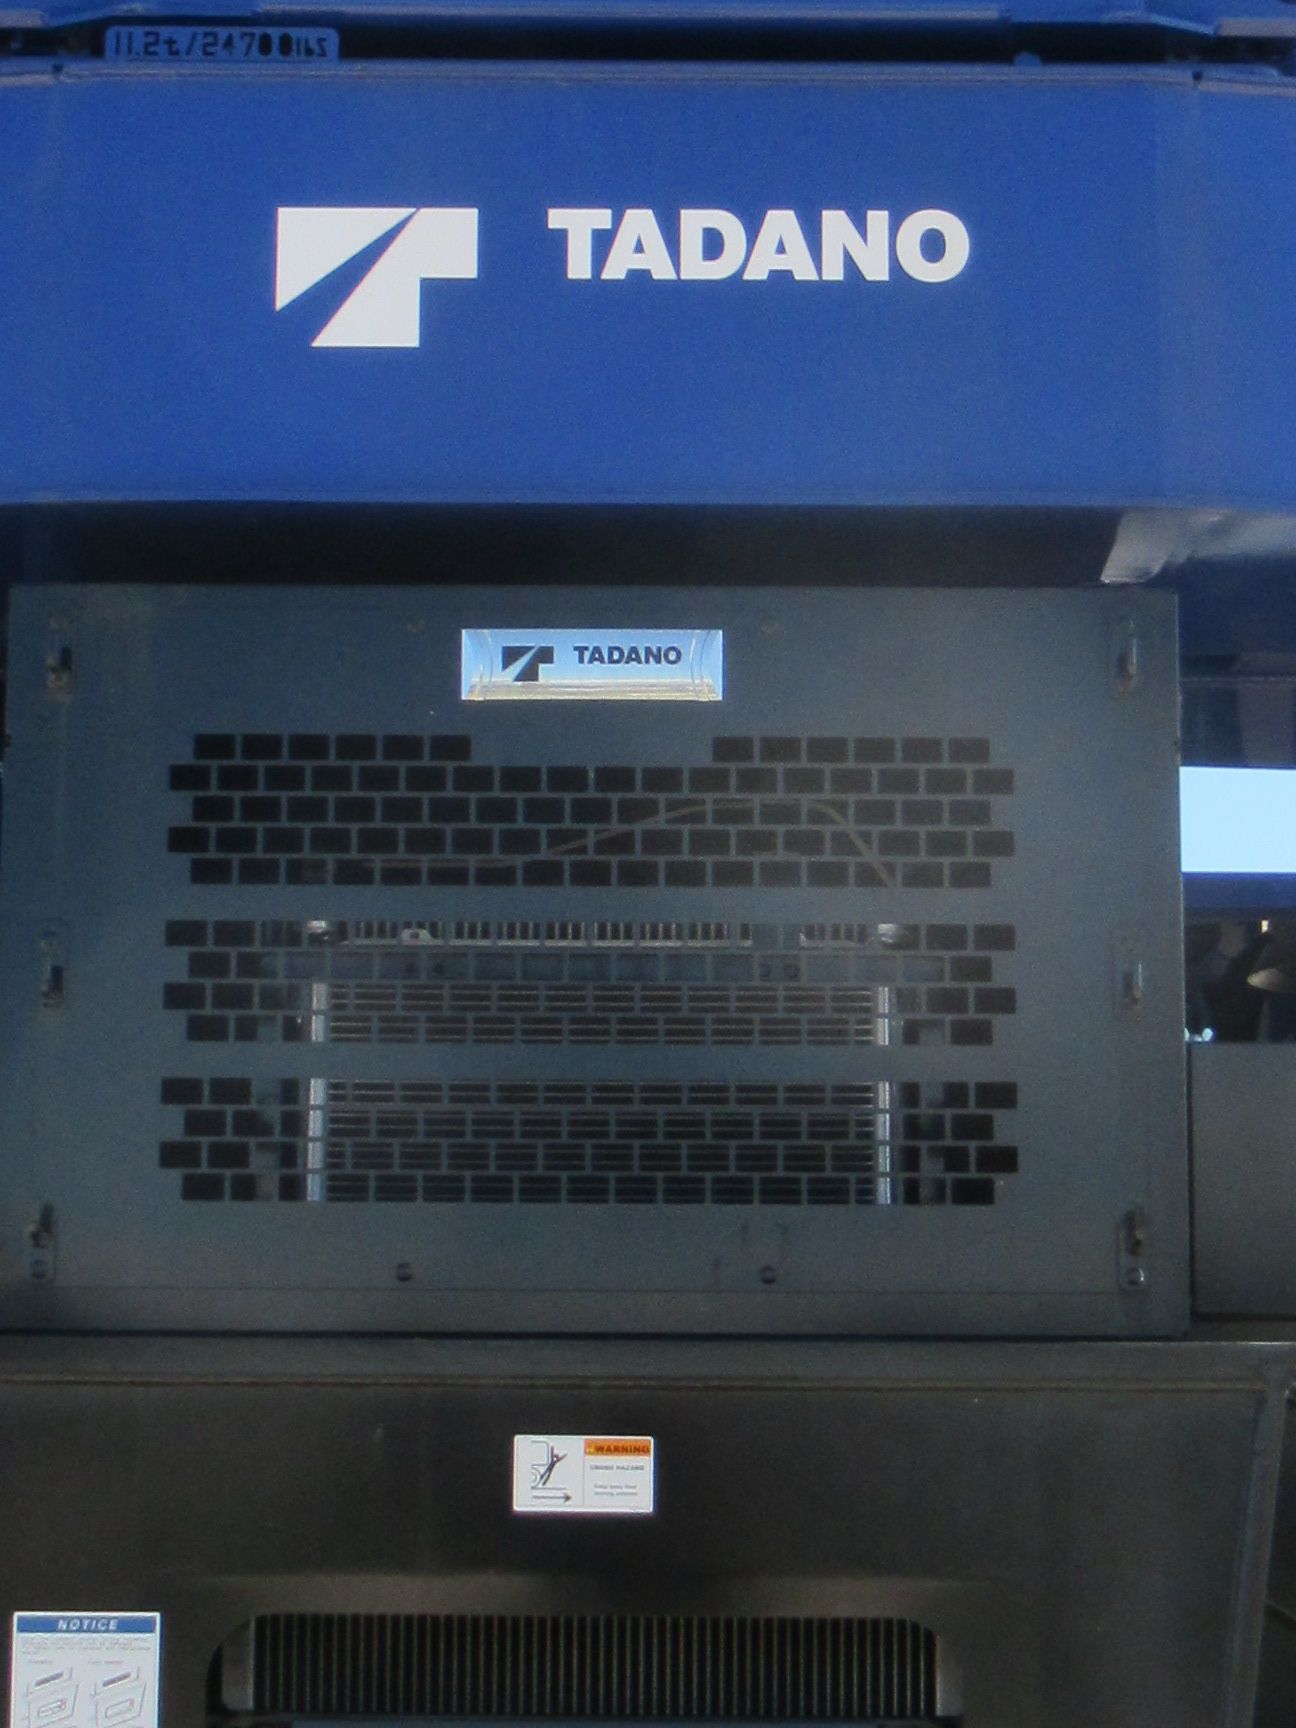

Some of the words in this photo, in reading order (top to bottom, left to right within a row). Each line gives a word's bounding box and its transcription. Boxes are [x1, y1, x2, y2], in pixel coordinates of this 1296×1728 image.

[547, 208, 971, 284] TADANO
[573, 645, 683, 665] TADANO
[595, 1444, 651, 1453] WARNING
[57, 1618, 119, 1631] NOTICE
